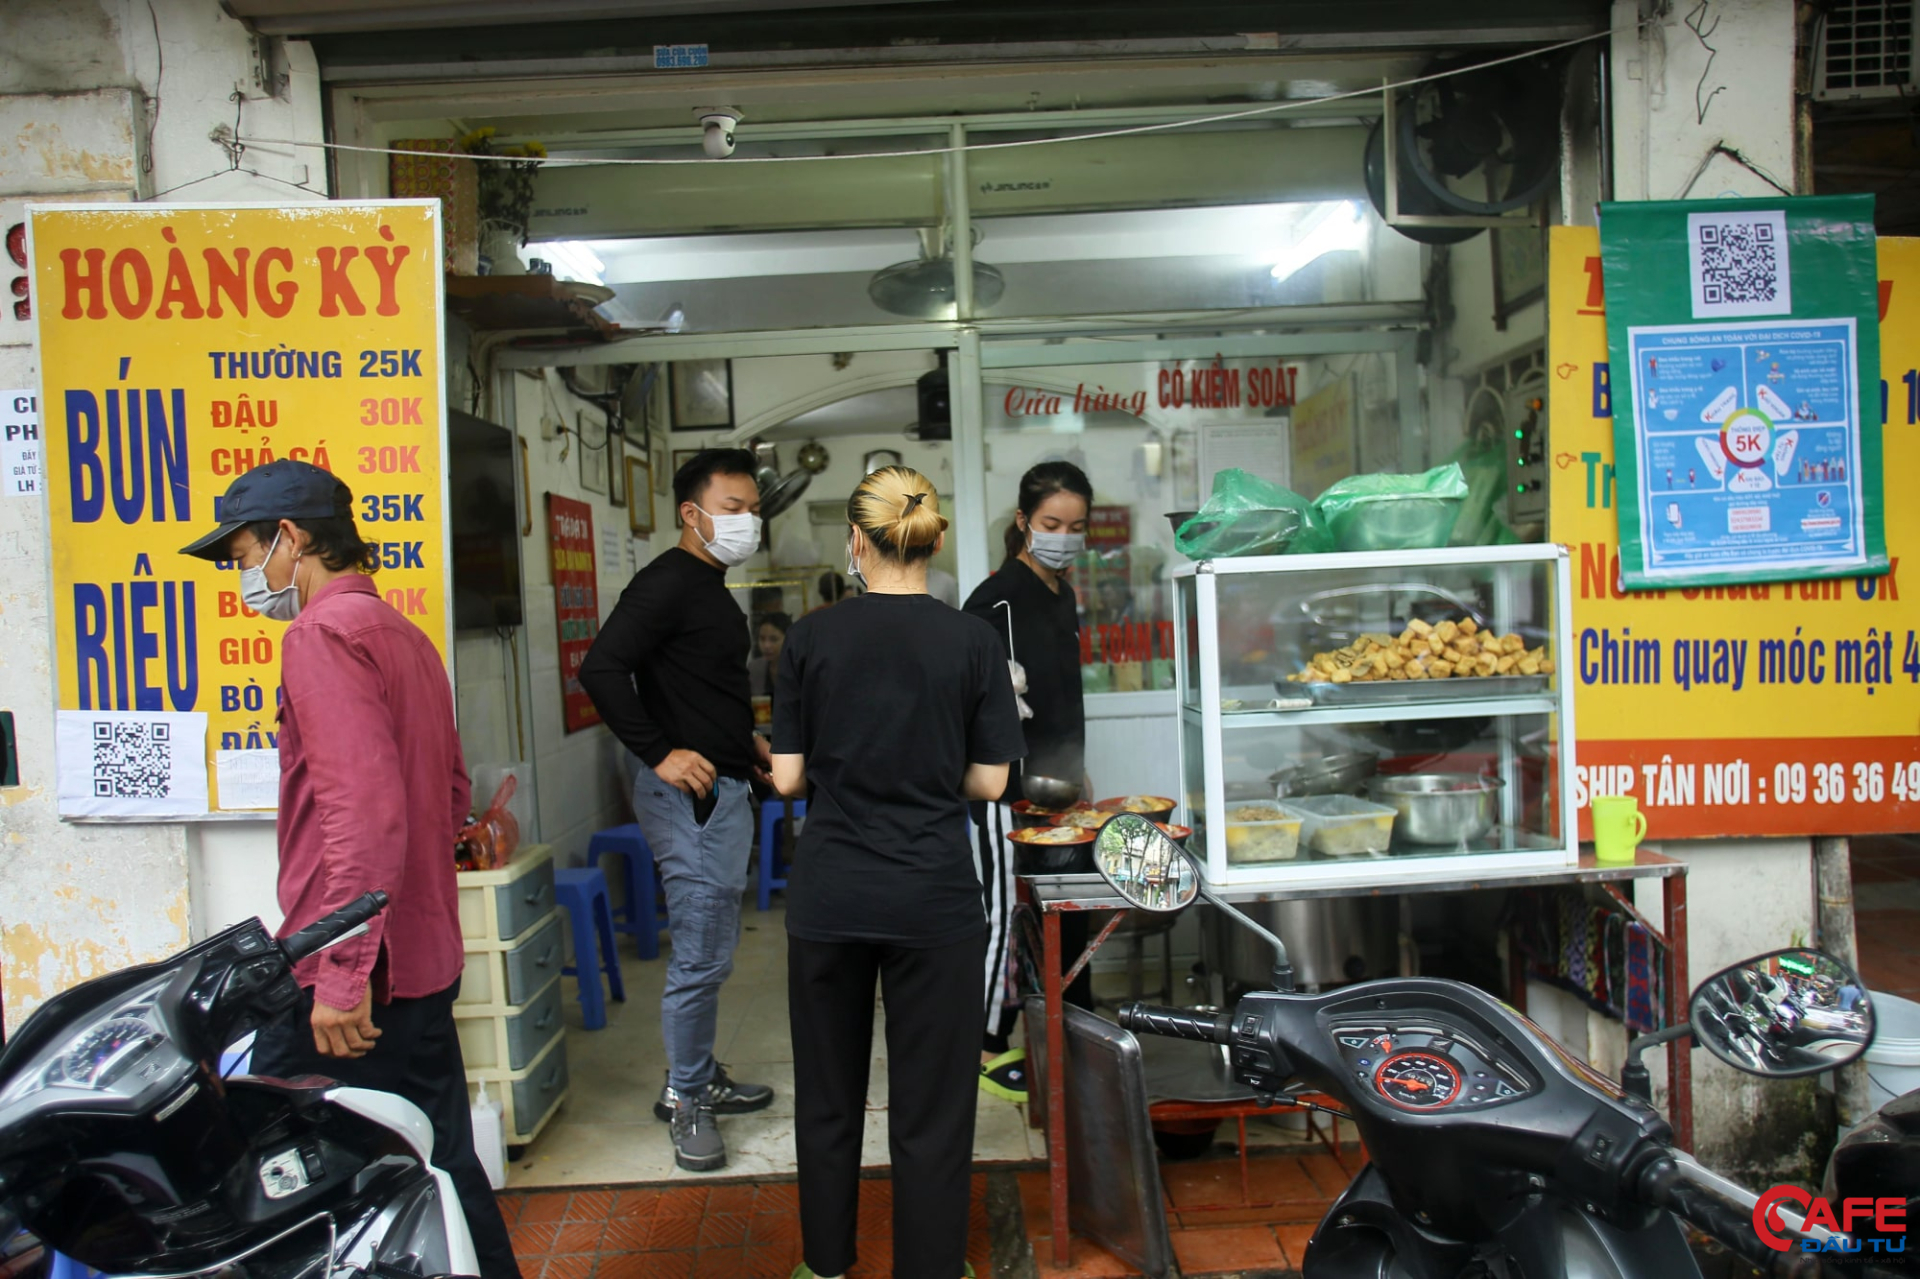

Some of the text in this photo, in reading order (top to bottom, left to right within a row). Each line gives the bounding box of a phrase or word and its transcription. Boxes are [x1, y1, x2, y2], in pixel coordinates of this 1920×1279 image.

[59, 226, 299, 321] HOÀNG
[316, 225, 411, 318] KỲ
[208, 344, 423, 379] THƯỜNG 25K
[1073, 383, 1148, 416] hàng
[1158, 360, 1183, 409] CÓ
[1191, 352, 1240, 408] KIỂM
[1247, 359, 1298, 408] SOÁT
[211, 393, 423, 434] ĐẬU 30K
[64, 357, 192, 525] BÚN
[211, 436, 275, 476] CHẢ
[358, 445, 421, 474] 30K
[1736, 433, 1762, 452] 5K
[361, 494, 425, 522] 35K
[385, 588, 428, 615] 0K
[73, 553, 199, 713] RIÊU
[219, 630, 273, 665] GIÒ
[1097, 615, 1153, 664] TOÀN
[1580, 627, 1661, 685] Chim
[1673, 638, 1747, 691] quay
[1758, 626, 1826, 685] móc
[1834, 628, 1893, 695] mật
[221, 678, 263, 712] BÒ
[1575, 765, 1634, 808] SHIP
[1703, 759, 1750, 805] NƠI
[1774, 763, 1806, 804] 09
[1813, 763, 1844, 804] 36
[1852, 762, 1884, 803] 36
